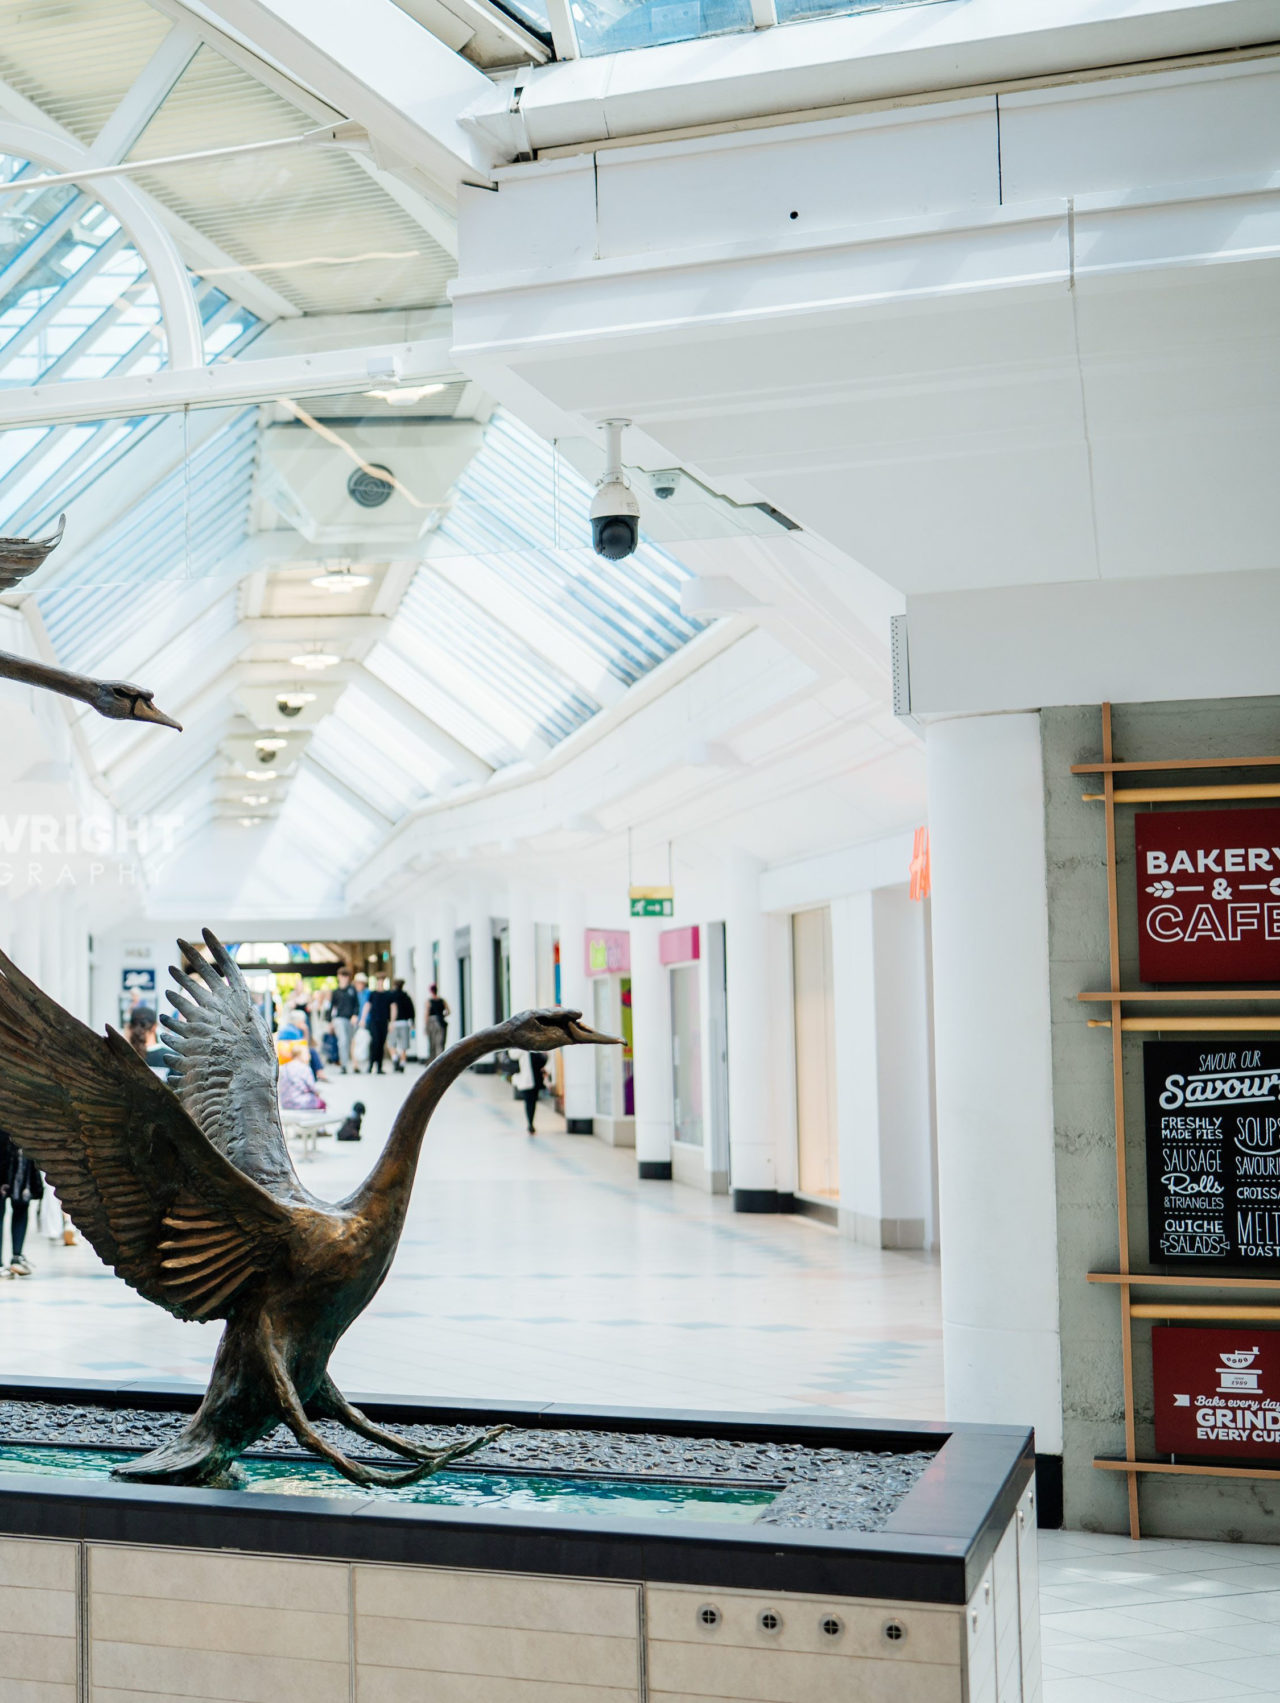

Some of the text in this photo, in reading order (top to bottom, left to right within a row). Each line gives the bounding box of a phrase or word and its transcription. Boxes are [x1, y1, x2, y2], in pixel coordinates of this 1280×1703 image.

[1211, 878, 1233, 900] &
[1146, 903, 1280, 943] CAFE
[1199, 1050, 1261, 1072] SAVOUR OUR
[1159, 1074, 1280, 1110] Savour
[1161, 1117, 1222, 1129] FRESHLY
[1237, 1117, 1280, 1146] SOUP
[1162, 1130, 1223, 1139] MADE PIES
[1163, 1149, 1222, 1172] SAUSAGE
[1236, 1156, 1280, 1175] SAVOURI
[1161, 1173, 1224, 1194] Rolls
[1237, 1187, 1280, 1199] CROISS
[1165, 1220, 1223, 1233] QUICHE
[1169, 1235, 1220, 1253] SALADS
[1194, 1395, 1226, 1407] Bake
[1228, 1400, 1260, 1411] every
[1196, 1408, 1280, 1430] GRIND
[1197, 1428, 1250, 1441] EVERY
